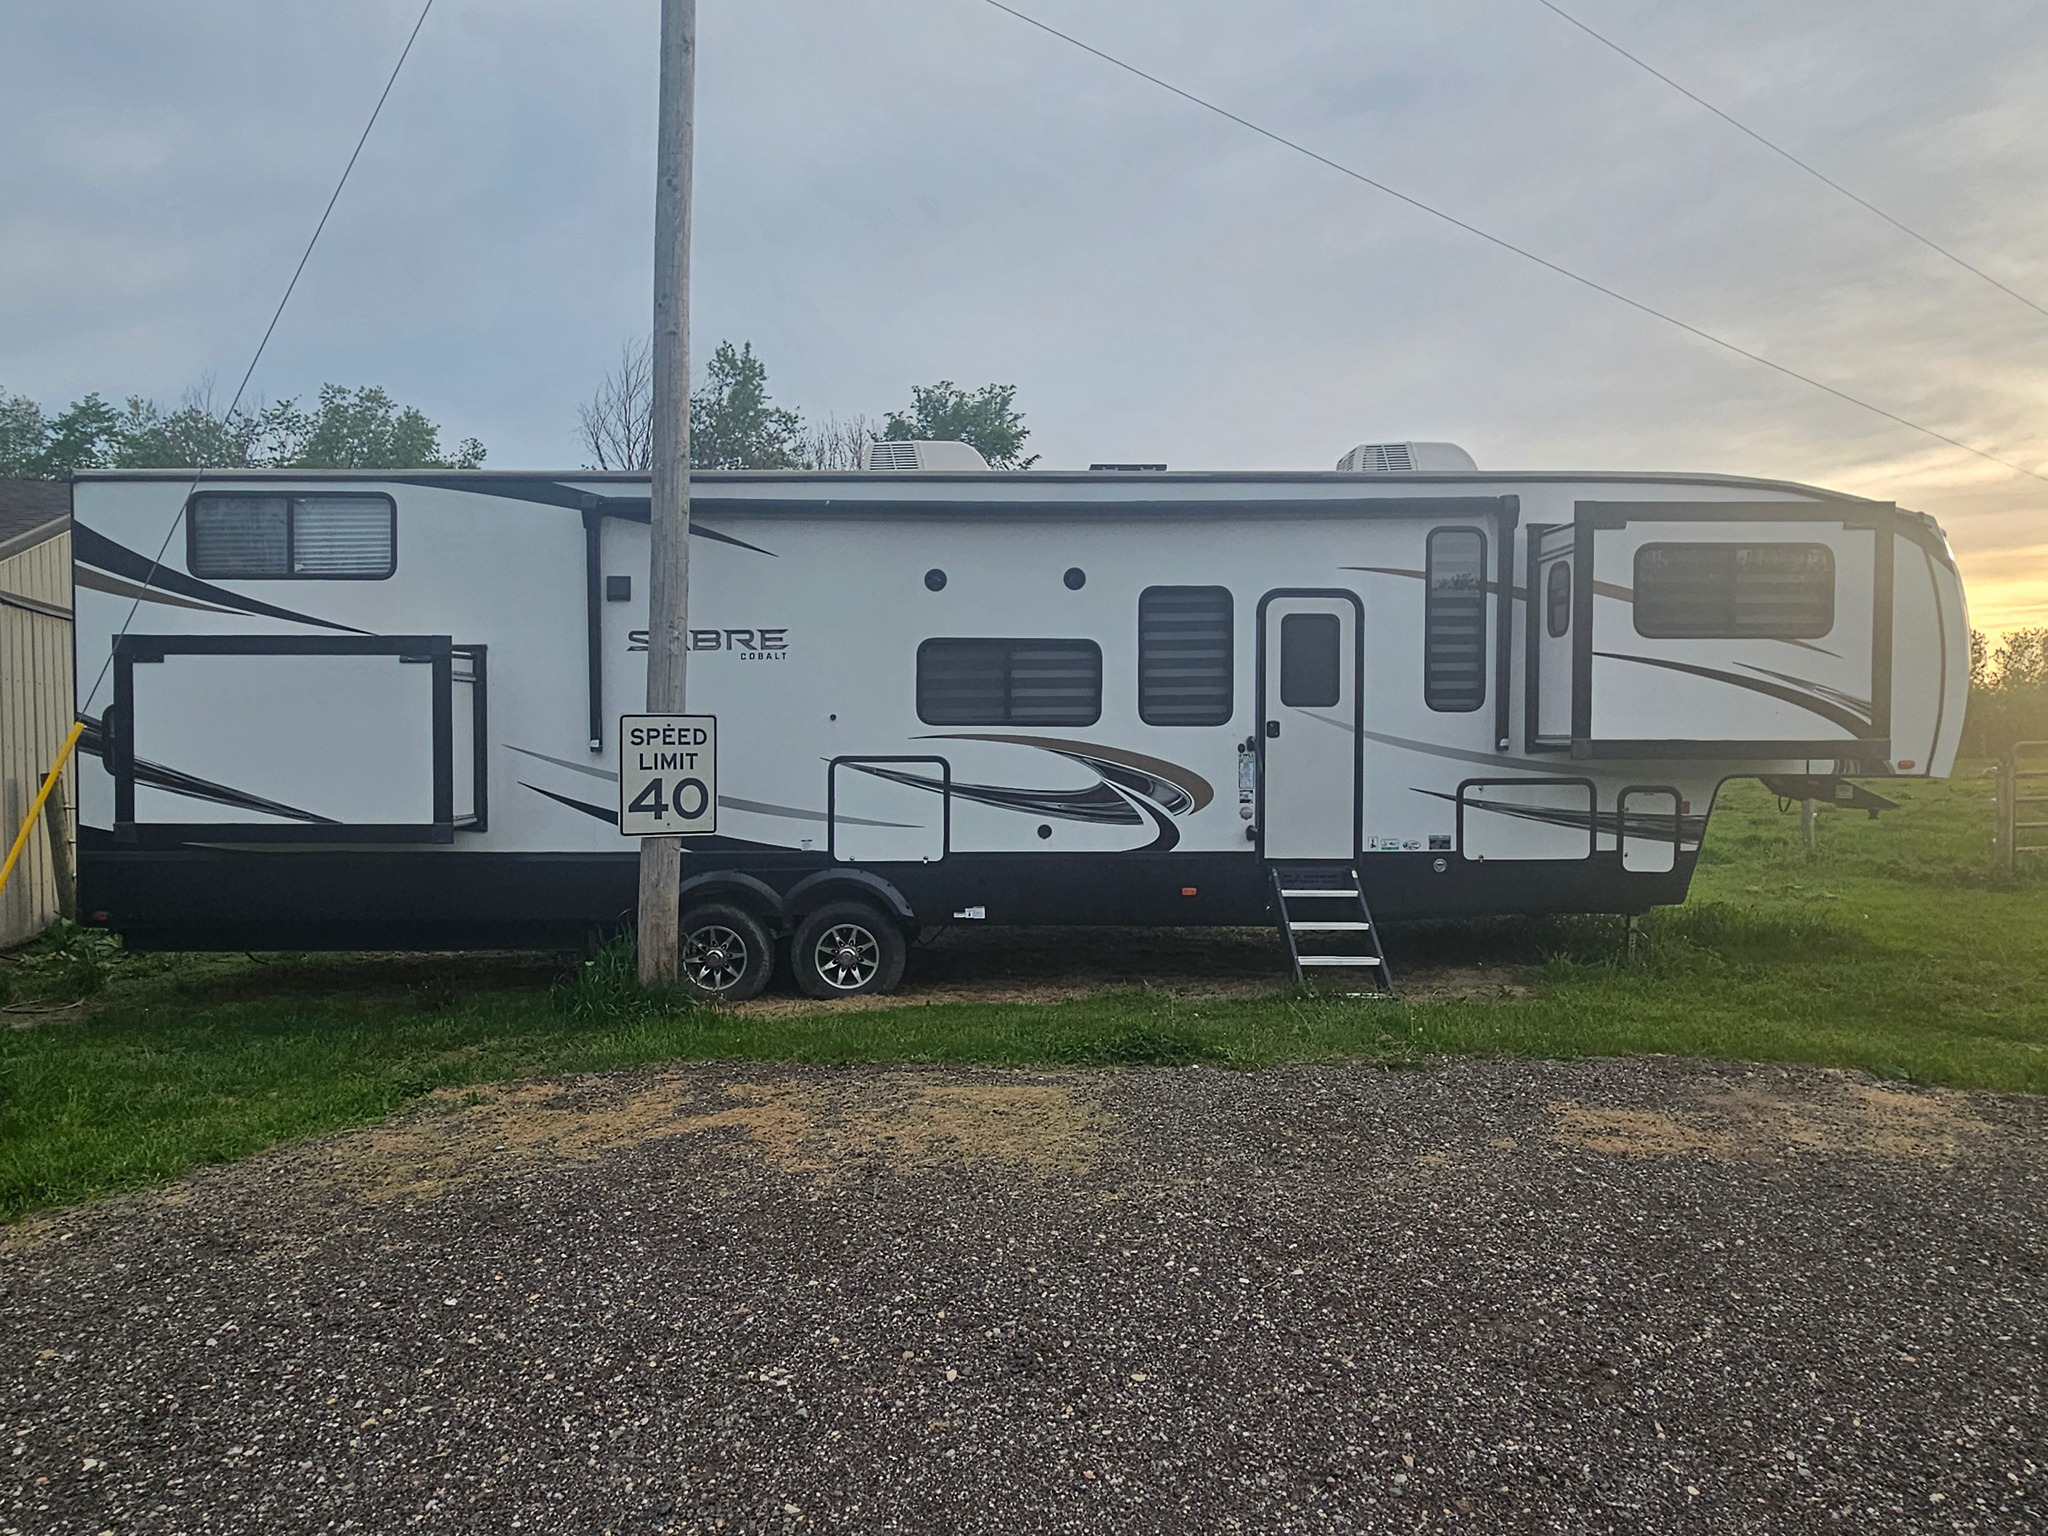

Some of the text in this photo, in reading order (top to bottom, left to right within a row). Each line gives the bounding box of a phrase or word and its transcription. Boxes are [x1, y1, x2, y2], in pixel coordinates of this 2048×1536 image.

[627, 629, 789, 651] SBRE
[740, 652, 787, 660] COBALT
[630, 728, 707, 746] SPEED
[639, 753, 698, 770] LIMIT
[628, 777, 709, 820] 40
